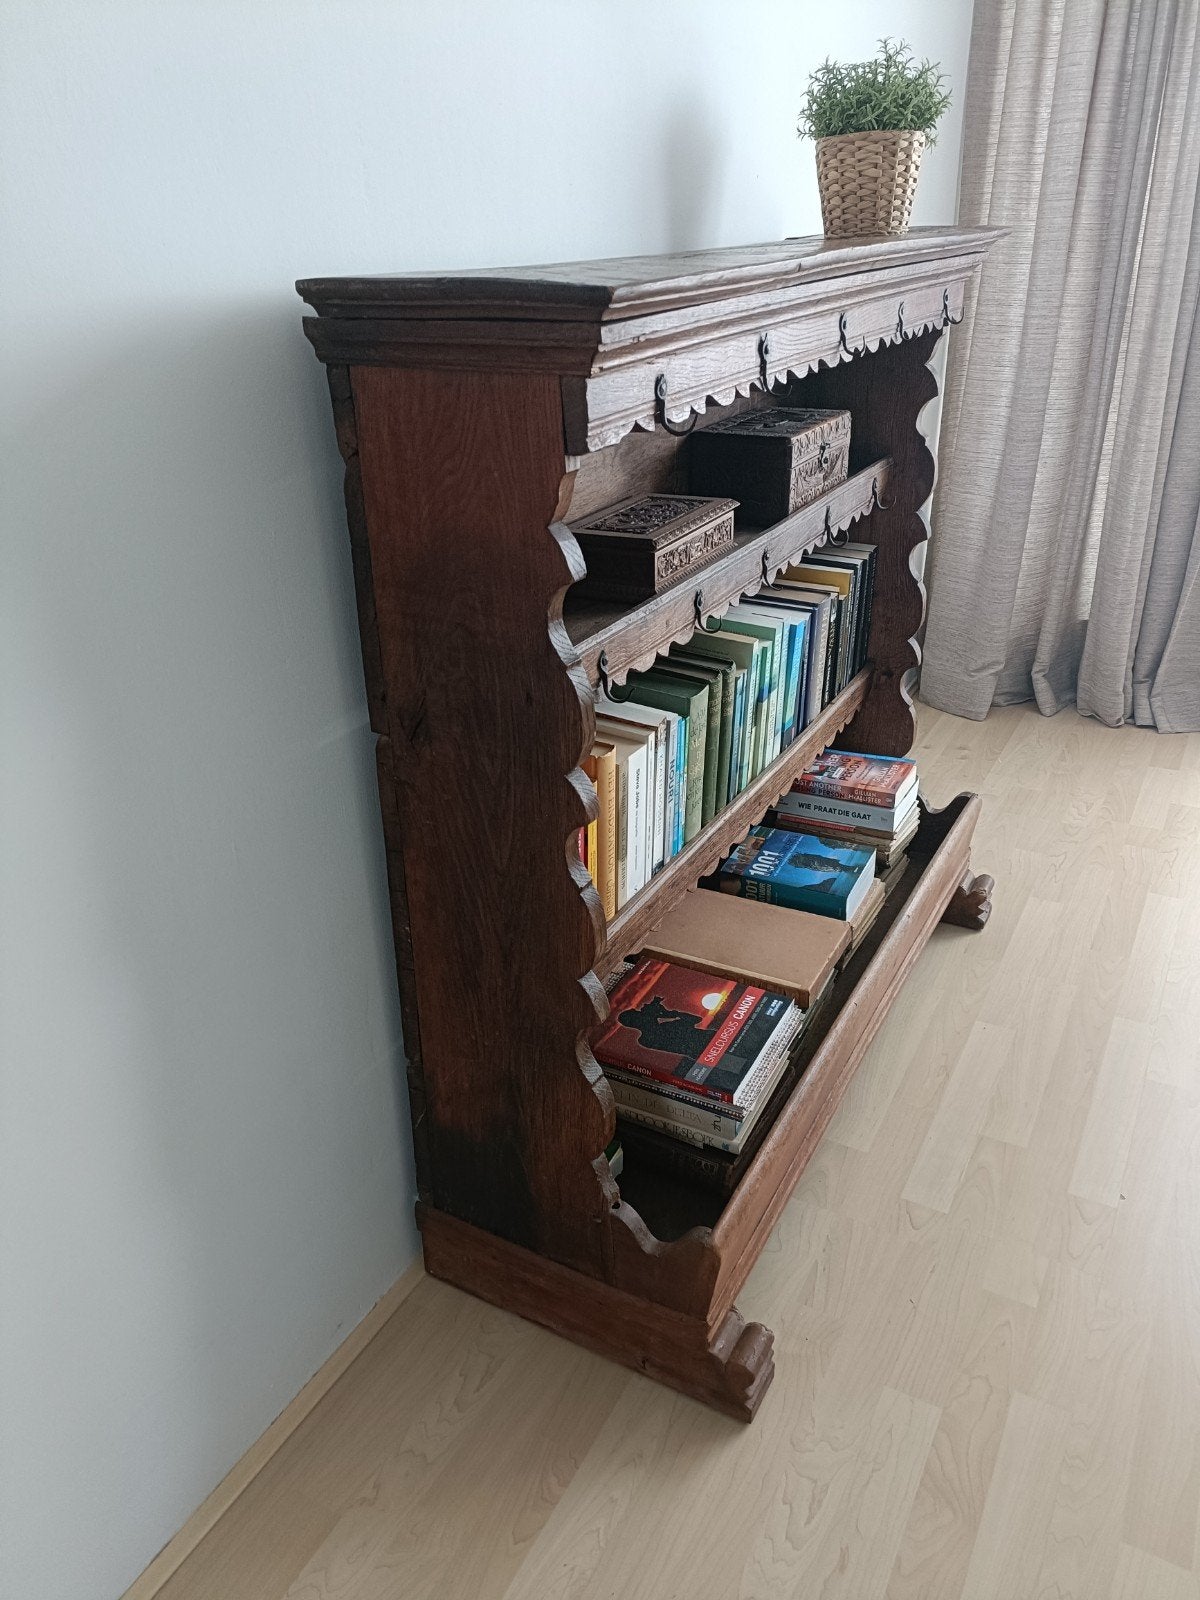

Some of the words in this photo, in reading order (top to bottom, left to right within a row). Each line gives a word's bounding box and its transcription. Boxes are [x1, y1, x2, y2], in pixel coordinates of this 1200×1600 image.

[607, 770, 615, 794] HET
[809, 780, 842, 792] ANOTHER
[818, 789, 845, 799] PERSON
[854, 789, 878, 797] GILLIAN
[798, 801, 812, 810] WIE
[813, 804, 837, 815] PRAAT
[837, 808, 850, 817] DIE
[851, 811, 872, 821] GAAT
[607, 798, 615, 874] EINDSTATION
[749, 850, 780, 876] 1001
[745, 879, 758, 900] 001
[704, 1021, 739, 1064] SNELCURSUS
[733, 995, 756, 1020] CANON
[627, 1063, 652, 1076] CANON
